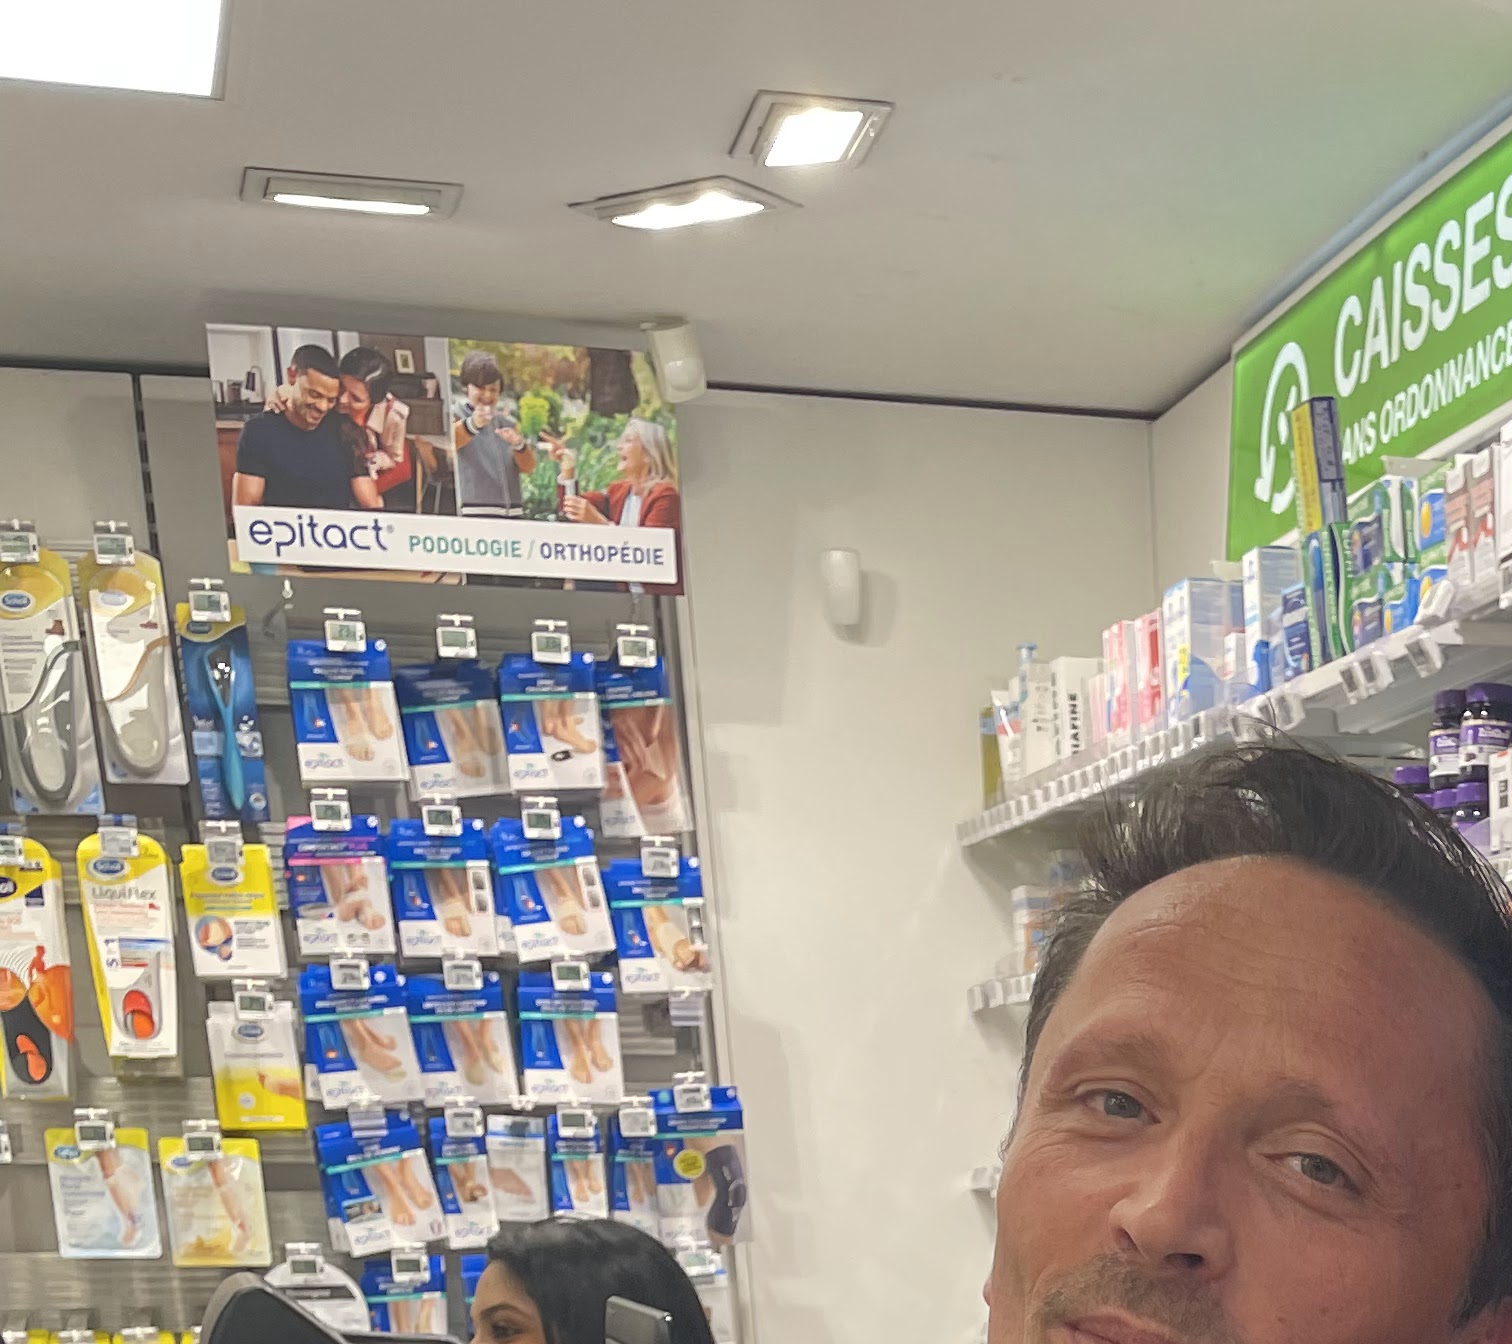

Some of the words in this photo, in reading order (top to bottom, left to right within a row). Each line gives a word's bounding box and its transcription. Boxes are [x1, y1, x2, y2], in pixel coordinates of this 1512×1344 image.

[1342, 411, 1377, 465] ANS
[249, 514, 388, 557] epitact
[408, 534, 522, 558] PODOLOGIE
[539, 541, 664, 566] ORTHOPÉDIE
